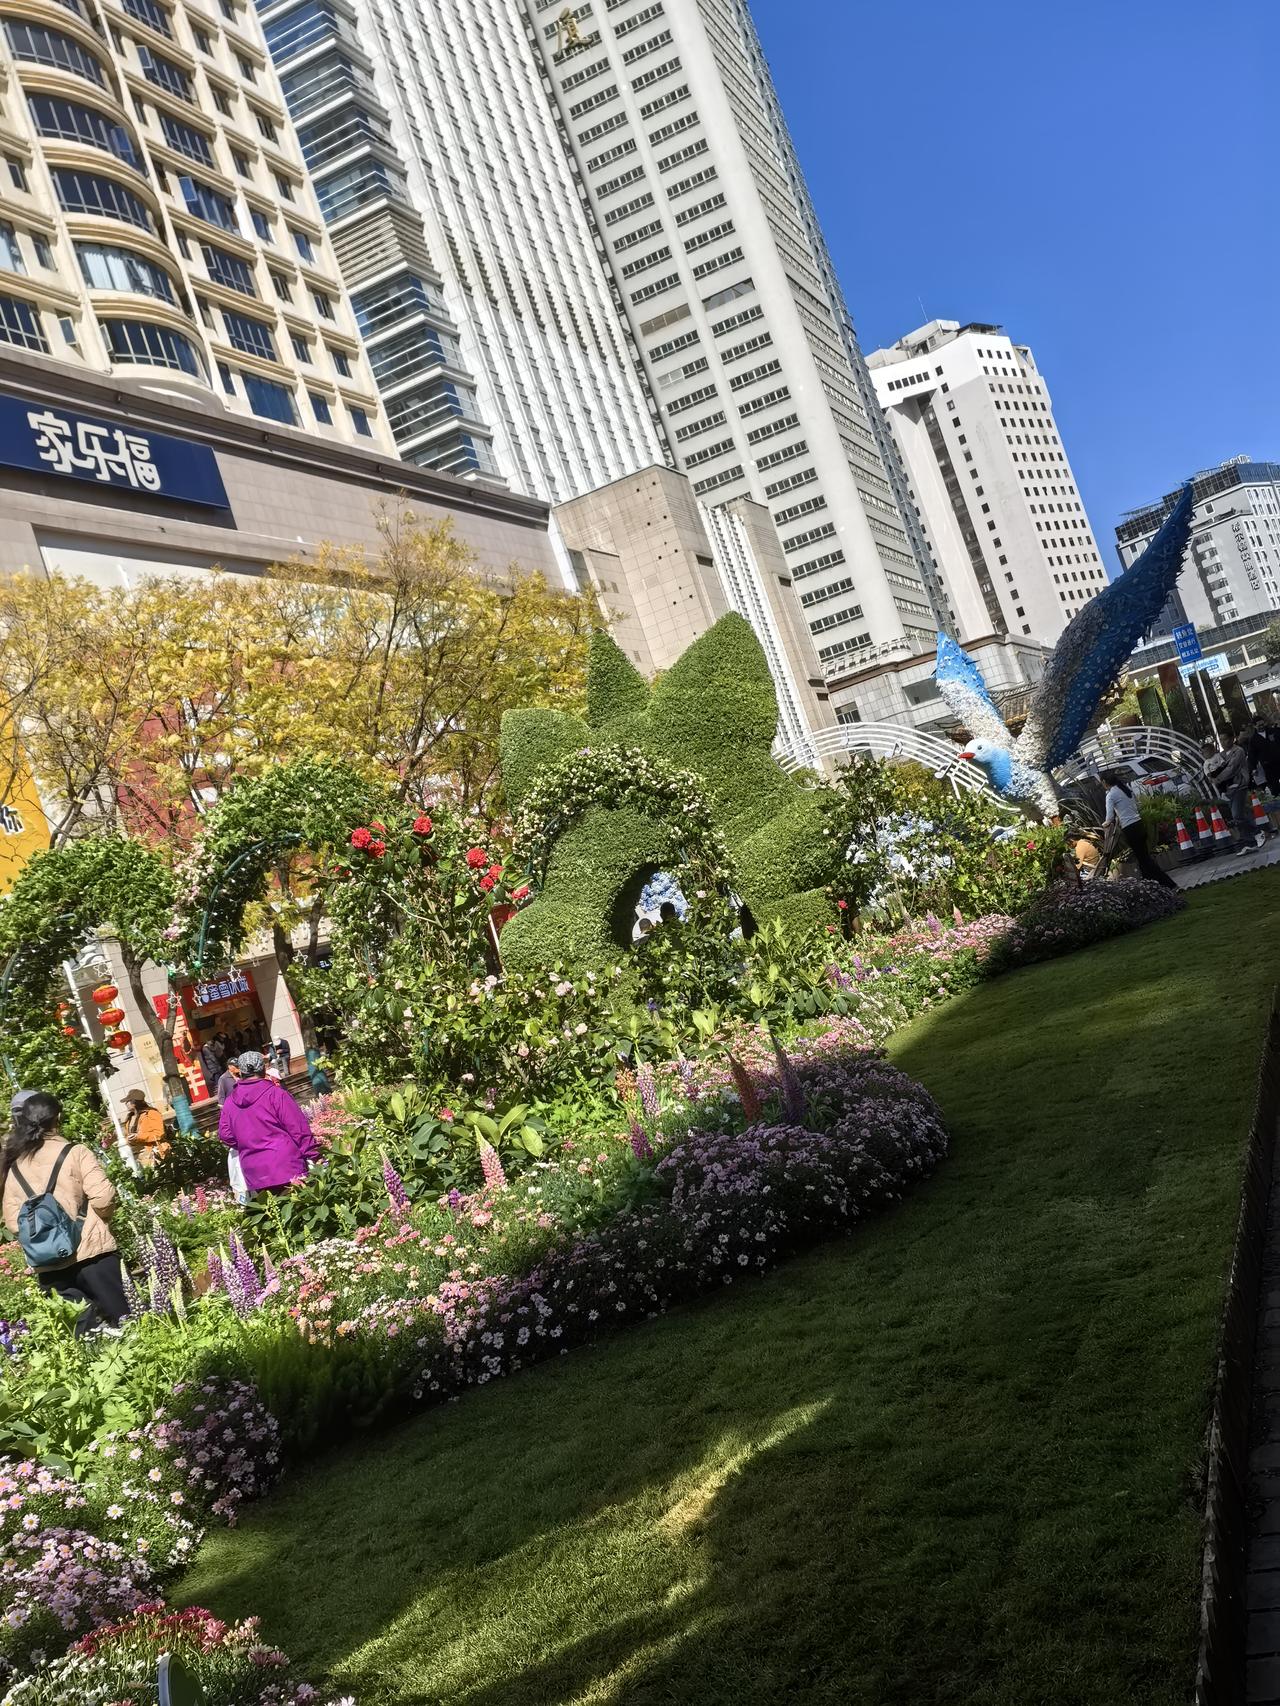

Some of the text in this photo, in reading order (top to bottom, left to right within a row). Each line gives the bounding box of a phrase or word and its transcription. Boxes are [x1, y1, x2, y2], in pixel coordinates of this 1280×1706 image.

[27, 410, 161, 492] 家乐福
[208, 976, 250, 1001] 蜜雪冰城
